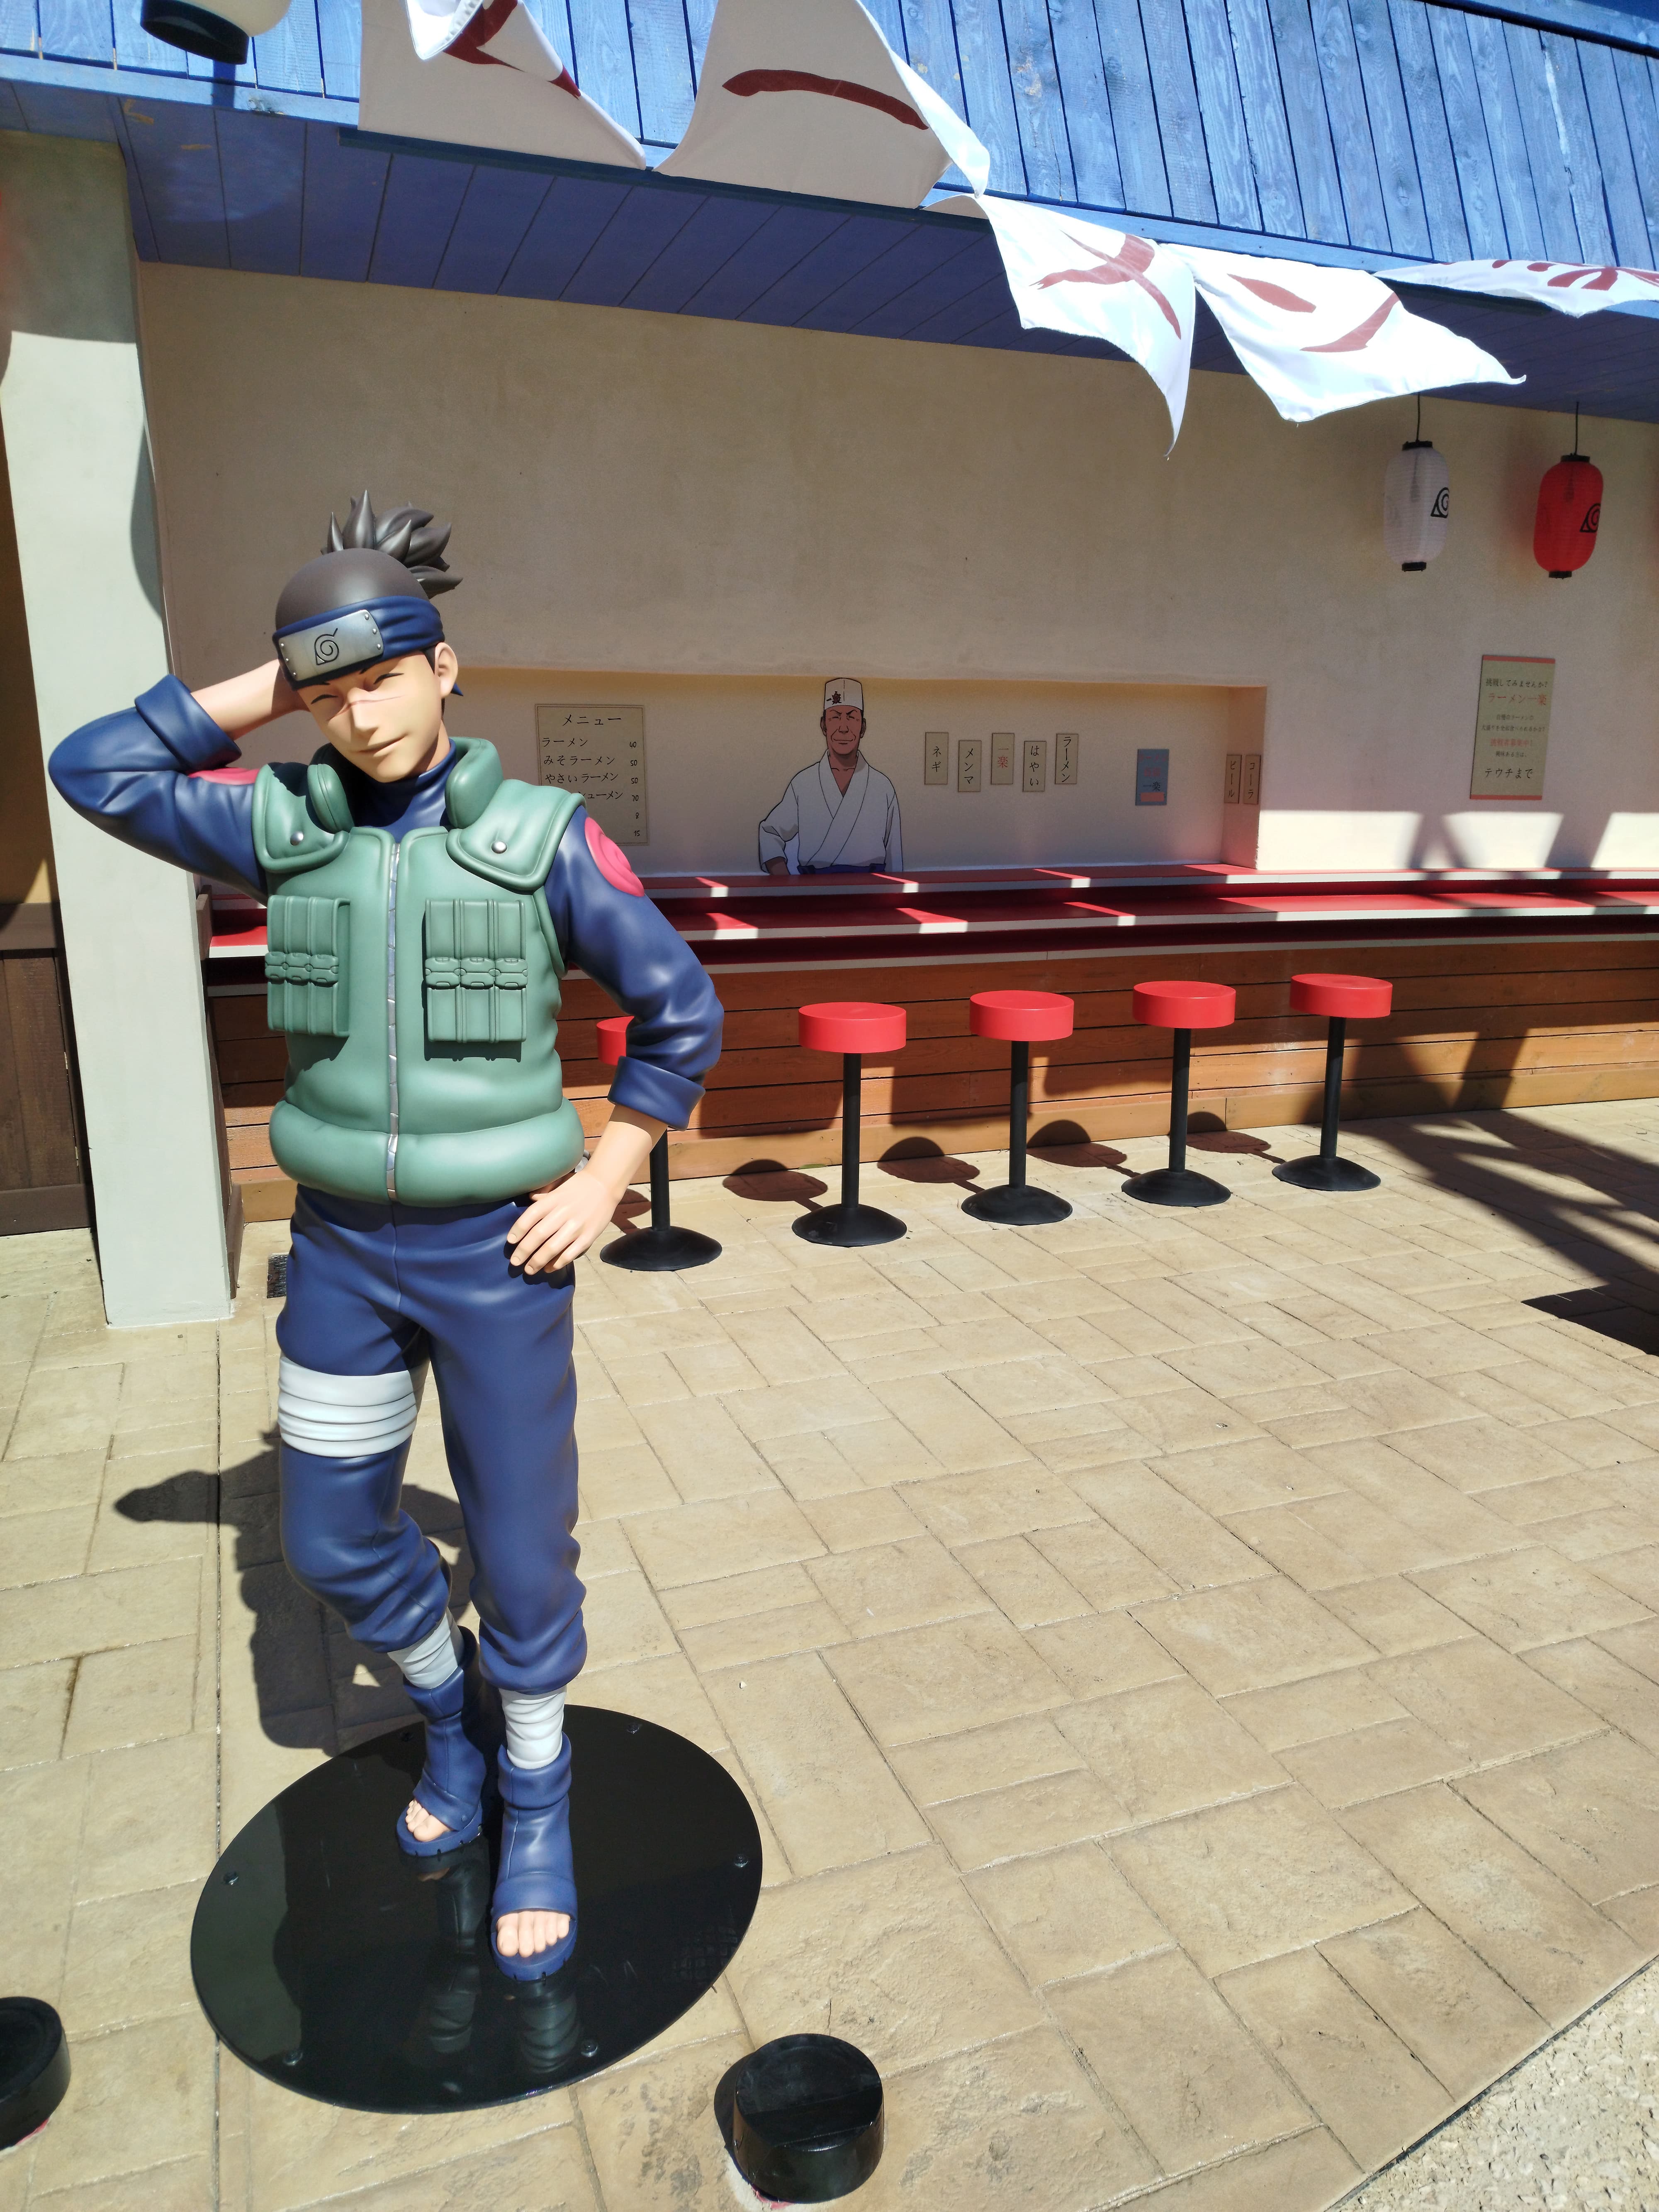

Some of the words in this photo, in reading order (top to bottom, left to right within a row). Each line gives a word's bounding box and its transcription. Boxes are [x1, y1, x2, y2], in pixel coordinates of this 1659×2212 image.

[562, 714, 621, 726] メニュー
[542, 737, 588, 747] ラーメン
[544, 755, 615, 766] みそラーメン
[932, 746, 941, 773] ネギ
[964, 748, 974, 784] メンマ
[998, 747, 1009, 769] 一楽
[1029, 745, 1039, 786] はやい
[1061, 736, 1071, 783] ラーメン
[545, 772, 618, 784] やさいラーメン
[1228, 761, 1236, 798] ビール
[1485, 768, 1533, 779] テウチまで
[1143, 781, 1161, 791] 一楽
